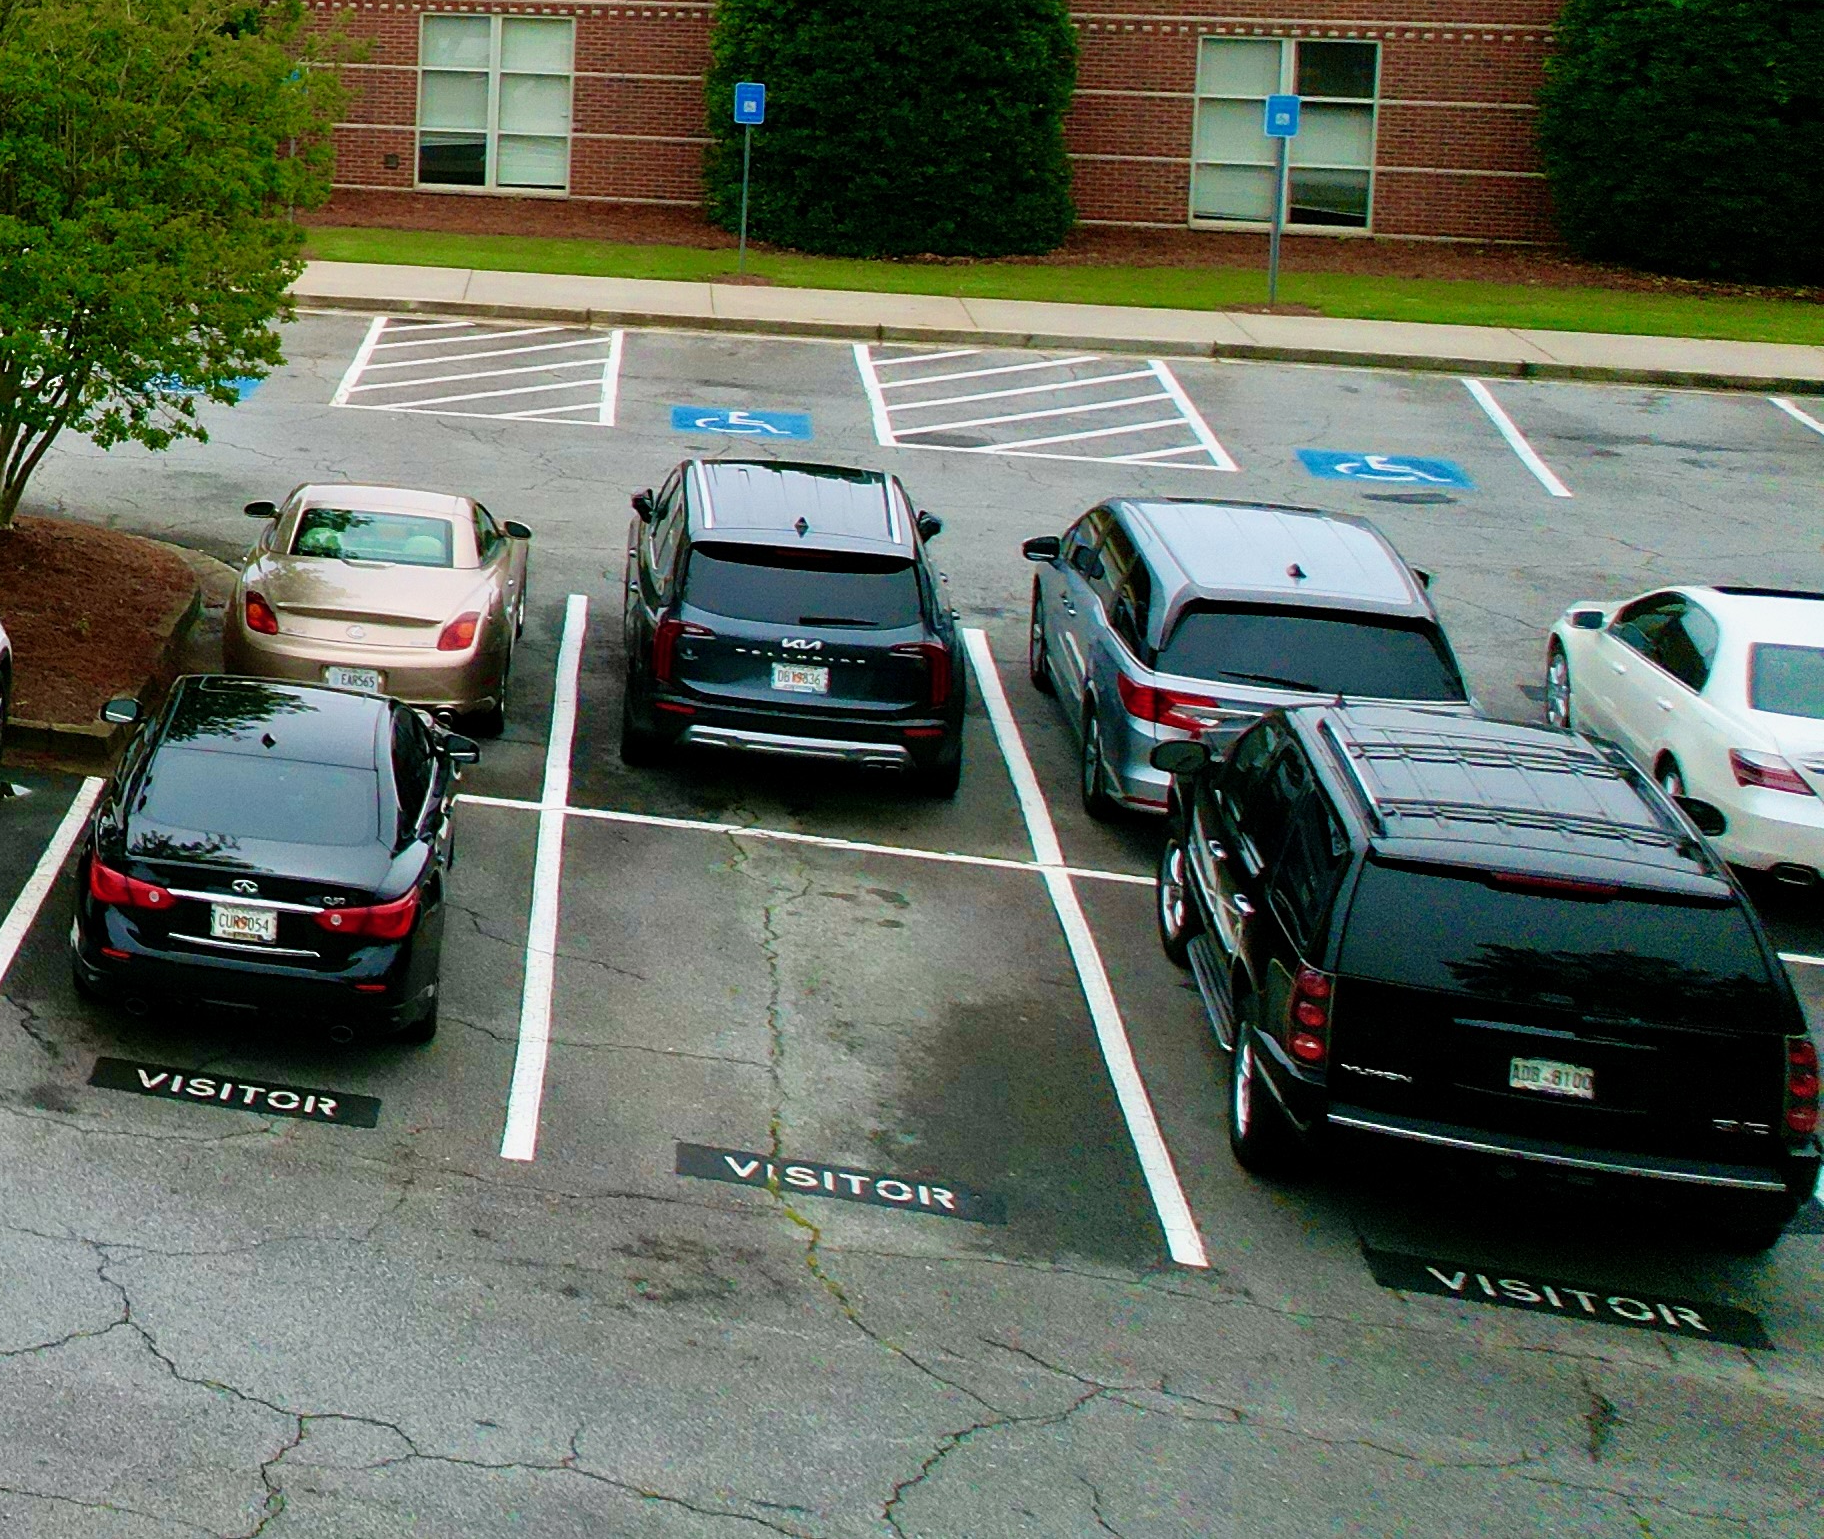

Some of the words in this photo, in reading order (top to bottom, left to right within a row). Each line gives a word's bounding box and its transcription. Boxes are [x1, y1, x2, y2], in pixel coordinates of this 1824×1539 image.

[136, 1067, 340, 1118] VISITOR
[723, 1155, 955, 1210] VISITOR
[1424, 1265, 1712, 1333] VISITOR
